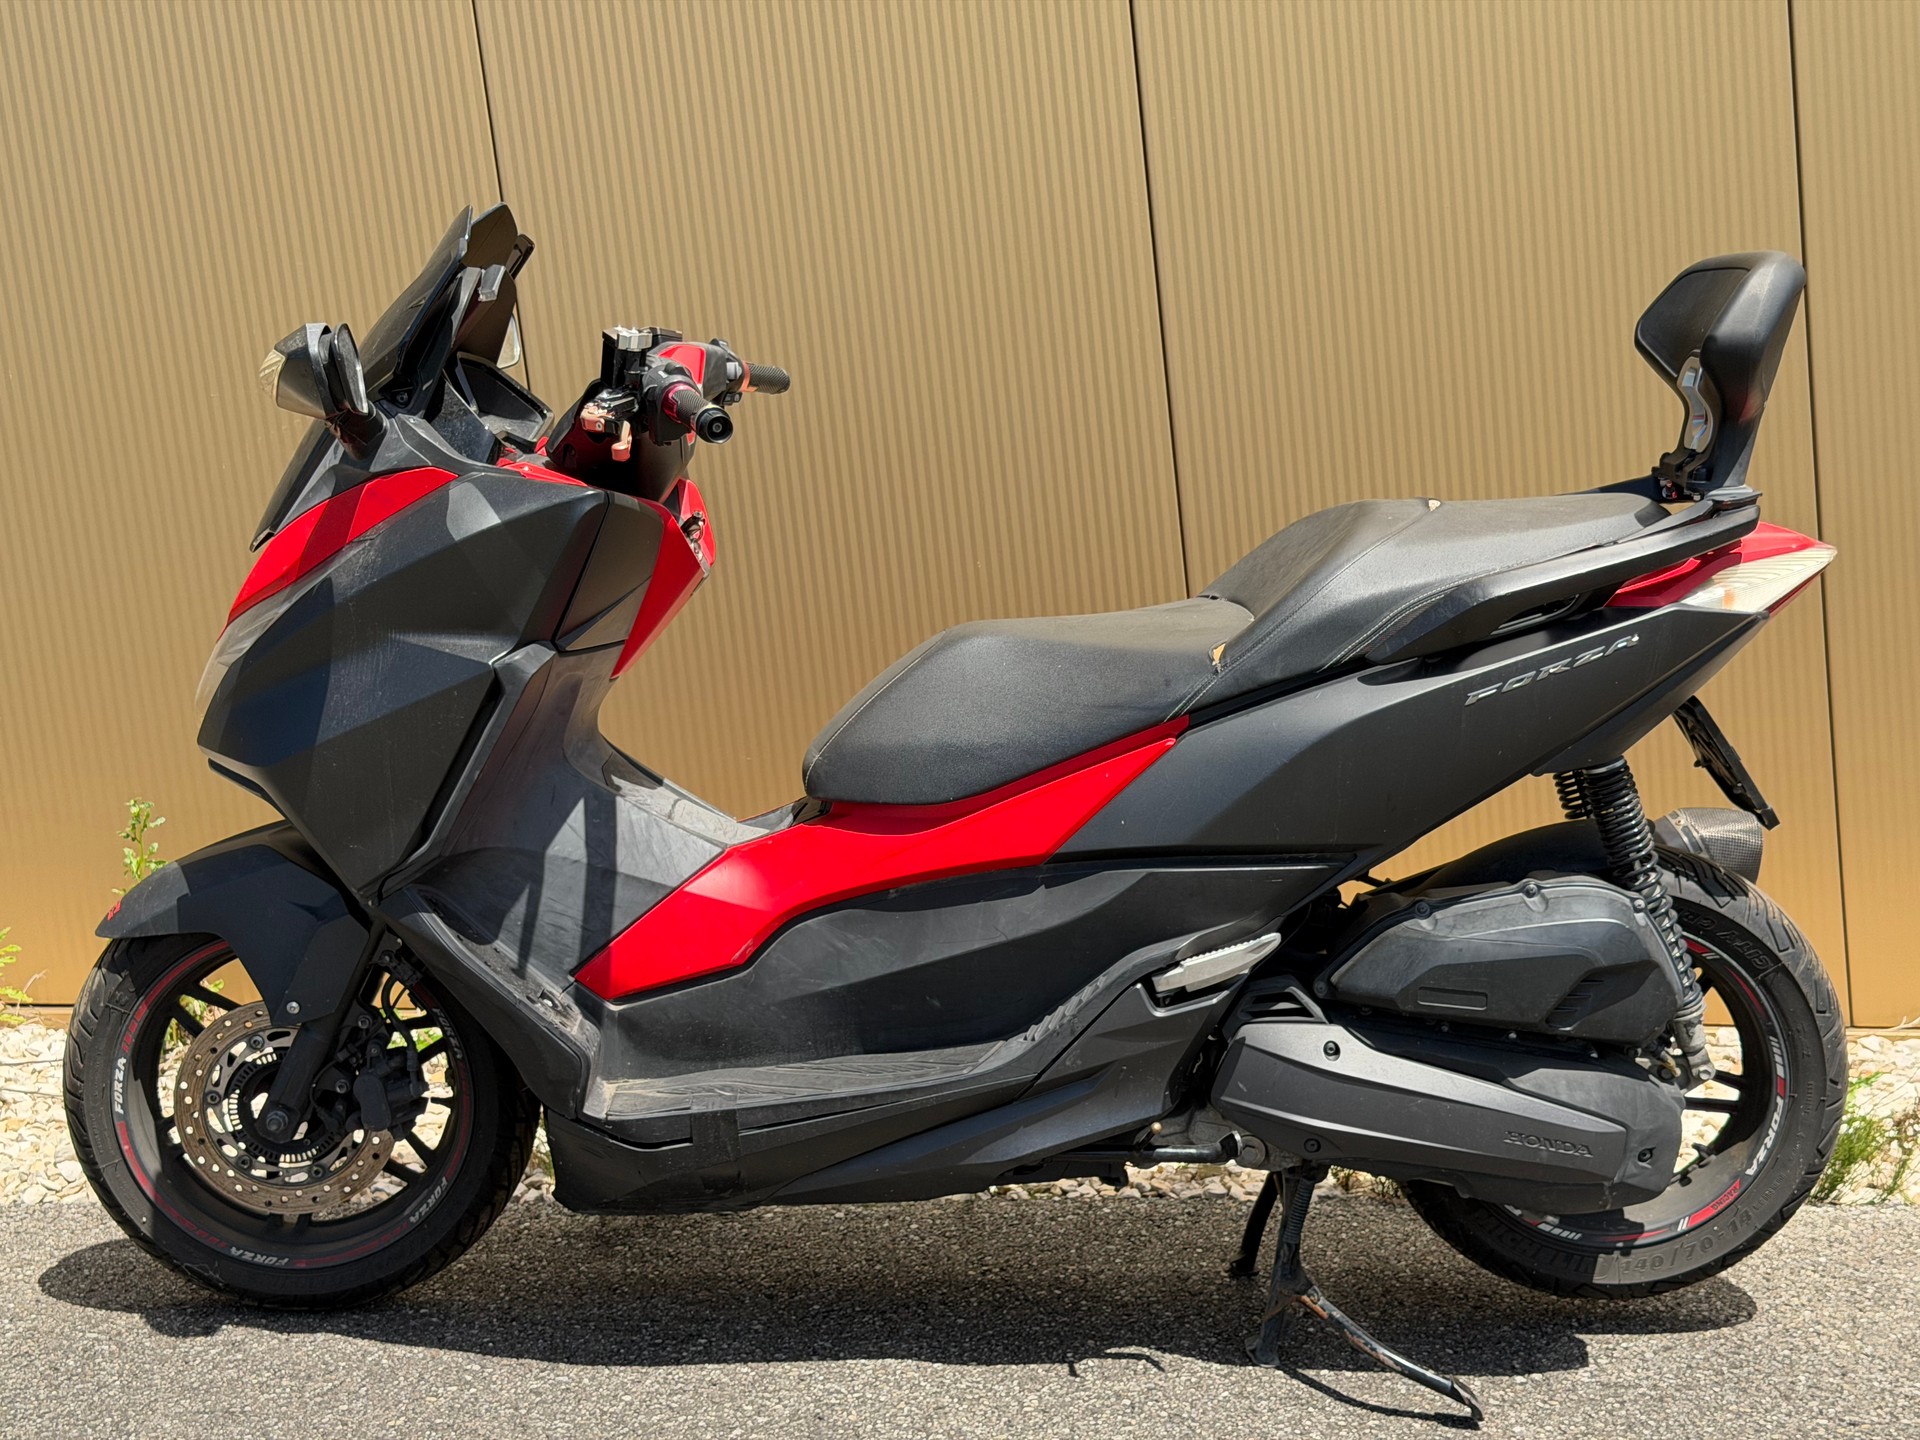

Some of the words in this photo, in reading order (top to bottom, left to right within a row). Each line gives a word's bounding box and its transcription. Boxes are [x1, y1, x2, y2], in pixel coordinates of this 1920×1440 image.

[1464, 635, 1640, 706] FORZA
[1714, 930, 1773, 970] CITY
[431, 1007, 463, 1060] FORZA
[113, 1056, 127, 1115] FORZA
[1503, 1131, 1593, 1158] HONDA
[1744, 1096, 1785, 1176] FORZA
[408, 1176, 449, 1224] FORZA
[1711, 1186, 1739, 1211] RACING
[229, 1246, 290, 1267] FORZA
